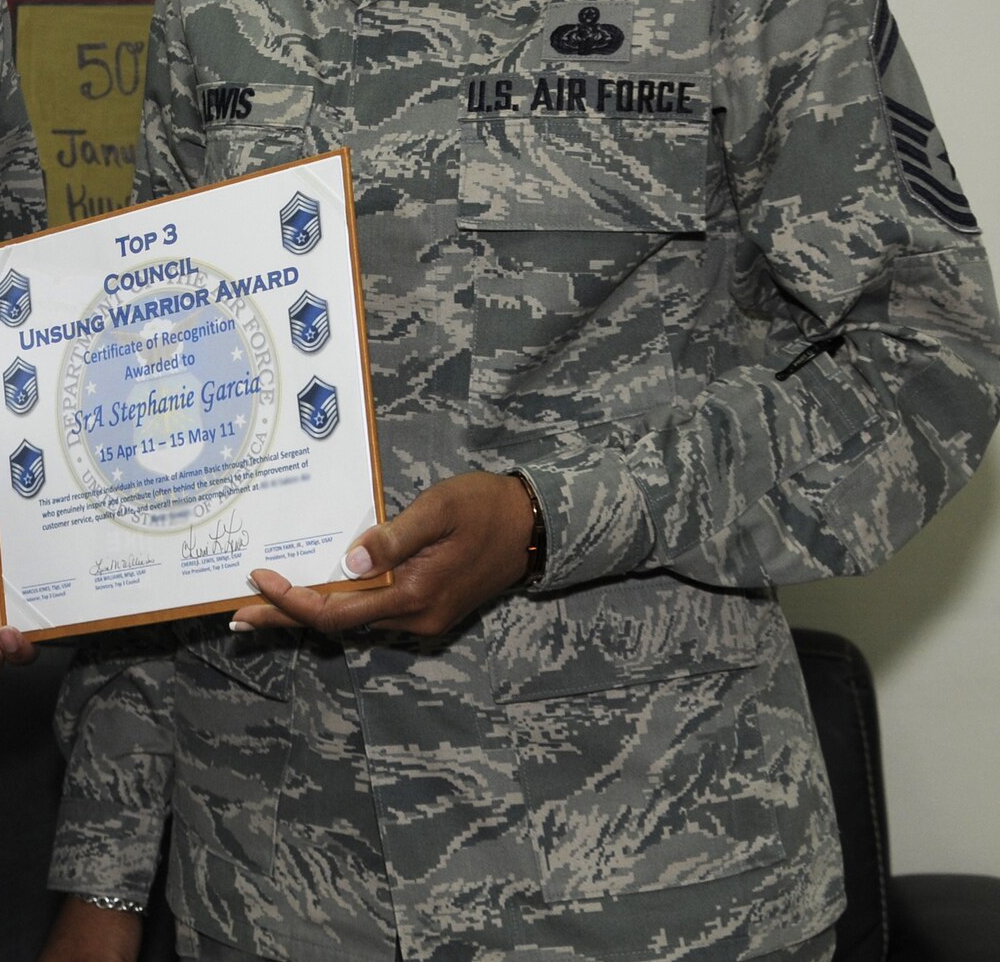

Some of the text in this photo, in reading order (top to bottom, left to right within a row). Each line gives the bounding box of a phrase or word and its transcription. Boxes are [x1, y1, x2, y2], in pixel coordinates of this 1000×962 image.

[467, 78, 695, 113] U.S. AIR FORCE
[163, 223, 178, 246] 3
[103, 257, 199, 295] COUNCIL
[19, 266, 299, 351] UNSUNG WARRIOR AWARD
[83, 318, 236, 365] Certificate of Recognition
[124, 353, 196, 381] Awarded to
[71, 371, 262, 435] SrA Stephanie Garcia
[100, 447, 113, 463] 15
[116, 443, 137, 462] Apr
[141, 438, 156, 454] 11
[169, 433, 185, 448] 15
[189, 427, 216, 445] May
[220, 422, 236, 438] 11
[39, 497, 51, 507] This
[52, 493, 71, 505] award
[137, 479, 143, 487] in
[144, 476, 154, 486] the
[155, 474, 169, 484] rank
[171, 472, 178, 481] of
[179, 468, 202, 481] Airman
[204, 465, 221, 476] Basic
[281, 447, 310, 461] Sergeant
[42, 510, 55, 519] who
[57, 504, 85, 518] genuinely
[173, 483, 195, 495] behind
[197, 479, 208, 489] the
[255, 463, 300, 478] improvement
[301, 459, 309, 469] of
[42, 521, 70, 531] customer
[252, 483, 259, 492] at
